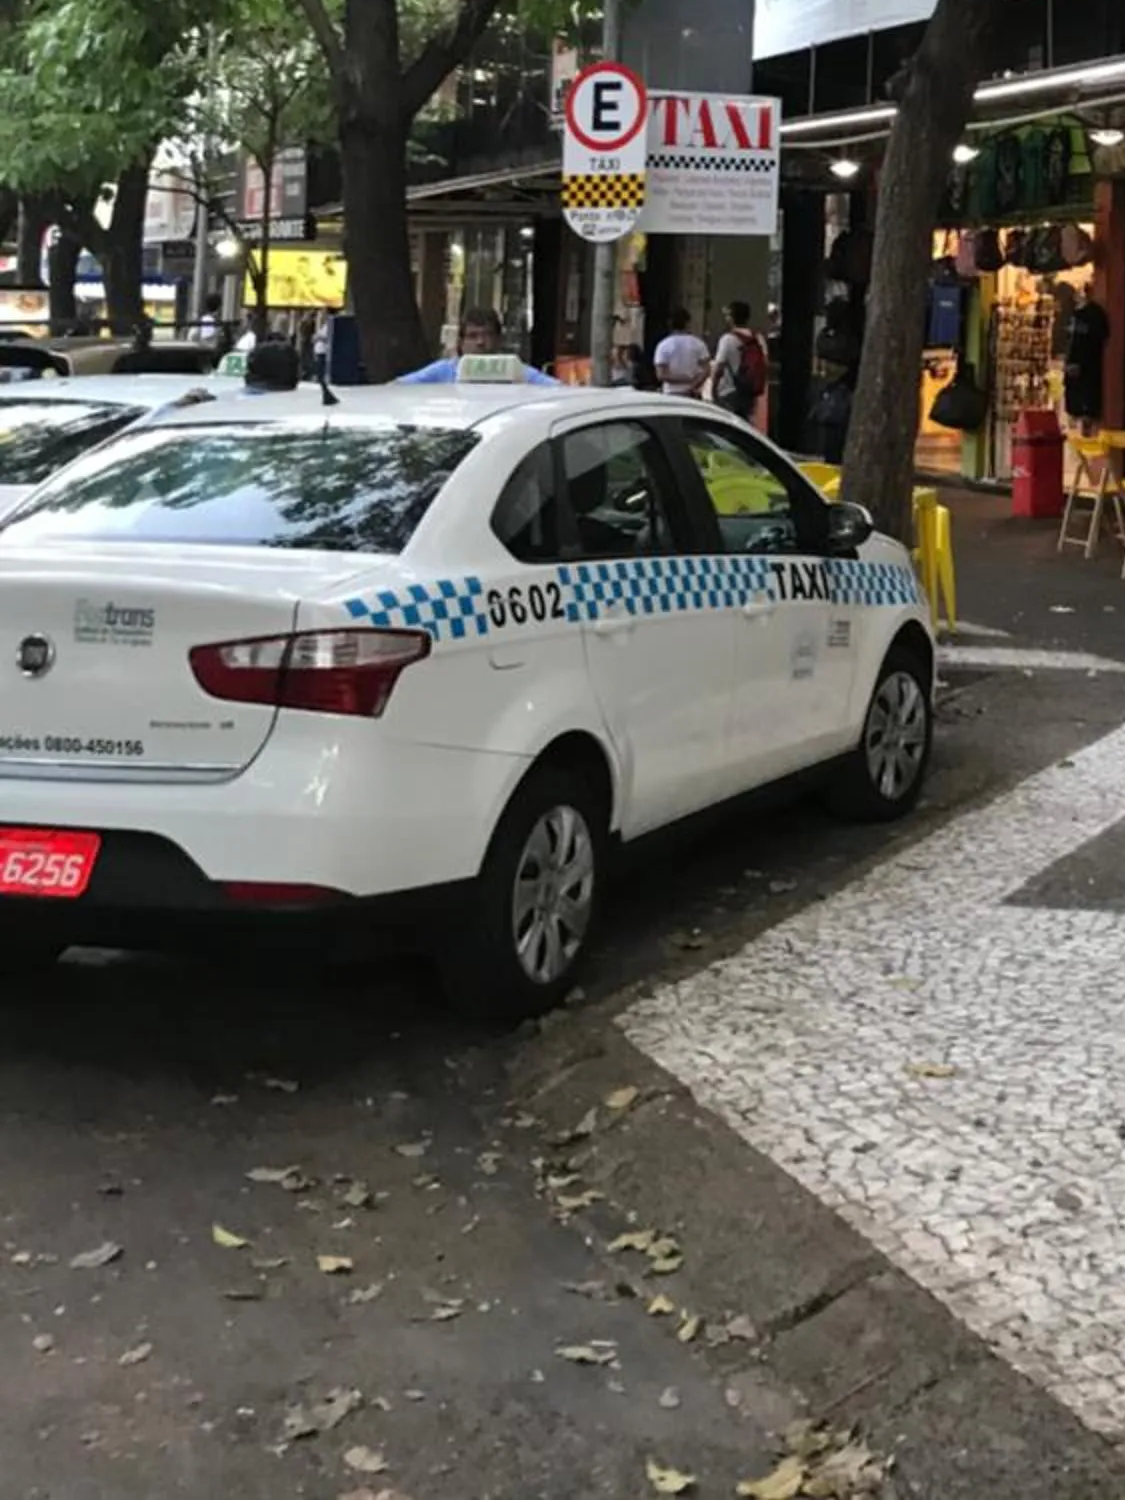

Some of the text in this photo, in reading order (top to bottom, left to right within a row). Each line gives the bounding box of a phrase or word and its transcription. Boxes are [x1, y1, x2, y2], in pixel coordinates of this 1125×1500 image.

[591, 81, 623, 132] E
[649, 95, 773, 151] TAXI
[487, 581, 565, 629] 0602
[770, 560, 832, 602] TAXI
